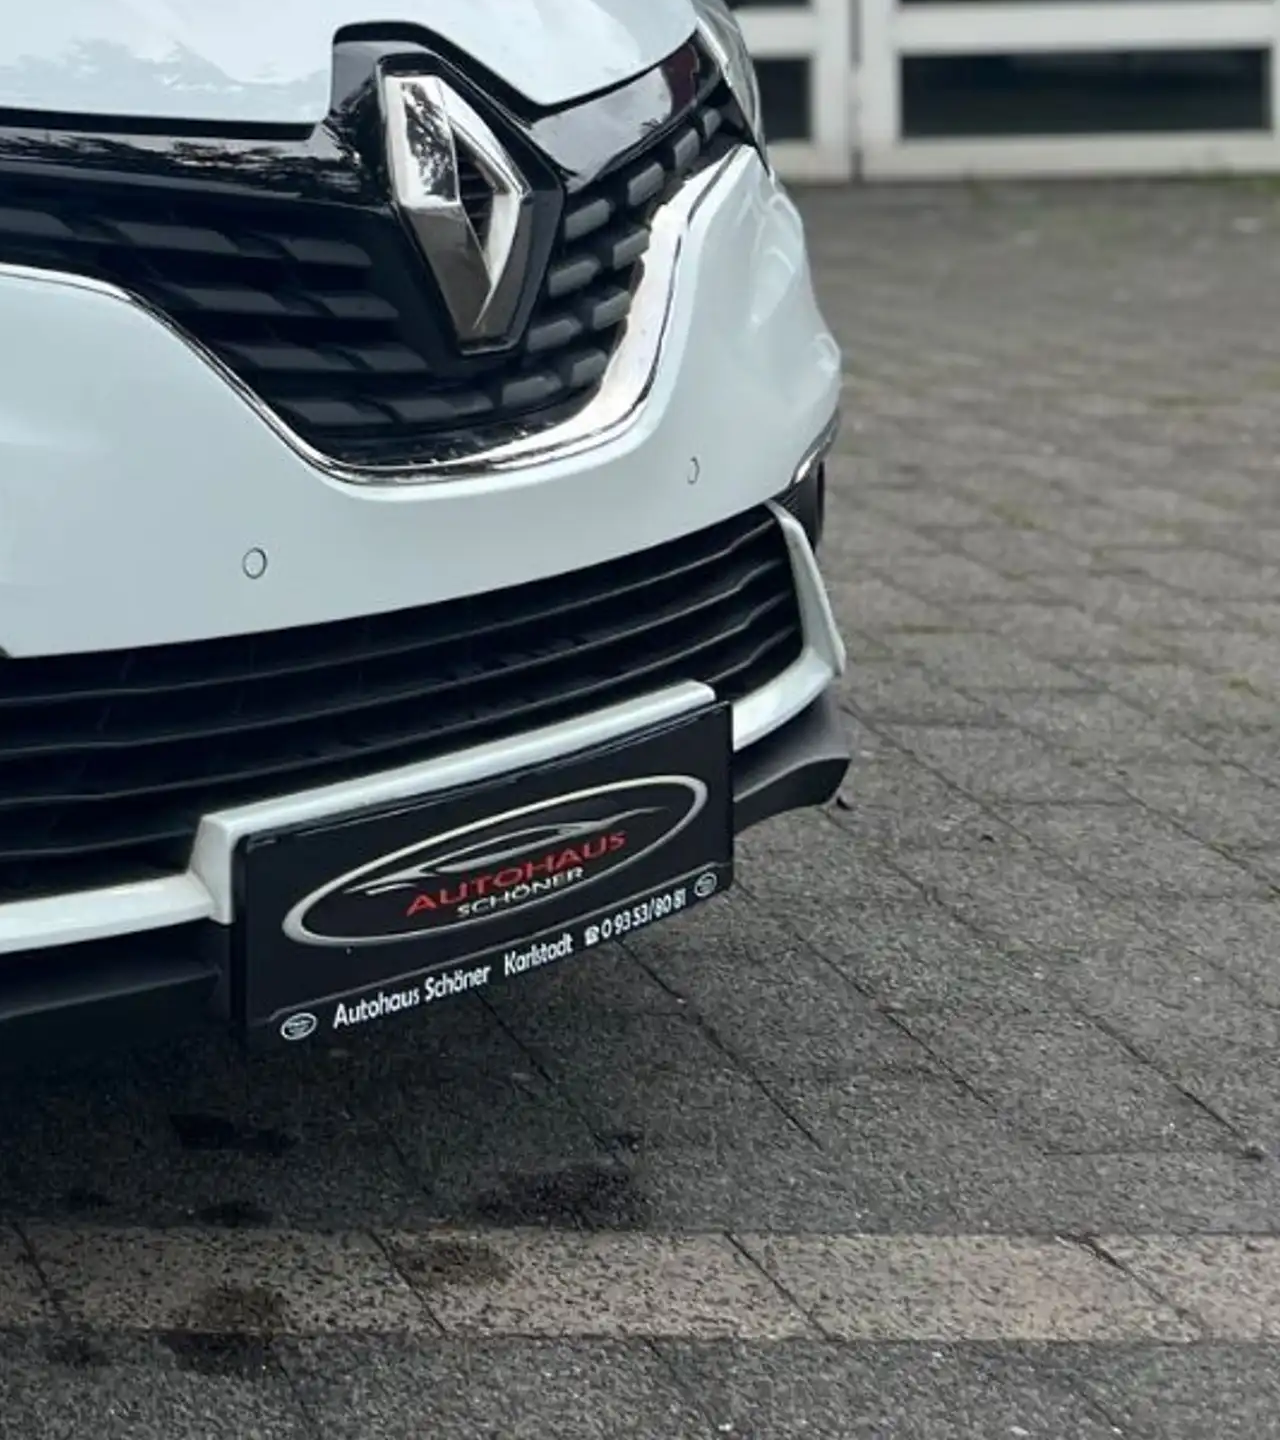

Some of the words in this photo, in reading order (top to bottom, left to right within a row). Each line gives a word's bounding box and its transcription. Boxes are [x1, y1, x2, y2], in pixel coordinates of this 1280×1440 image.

[406, 831, 626, 917] AUTOHAUS
[456, 866, 584, 917] SCHÖNER
[333, 988, 420, 1029] Autohaus
[424, 966, 491, 1002] Schöner
[504, 933, 574, 976] Karlstadt
